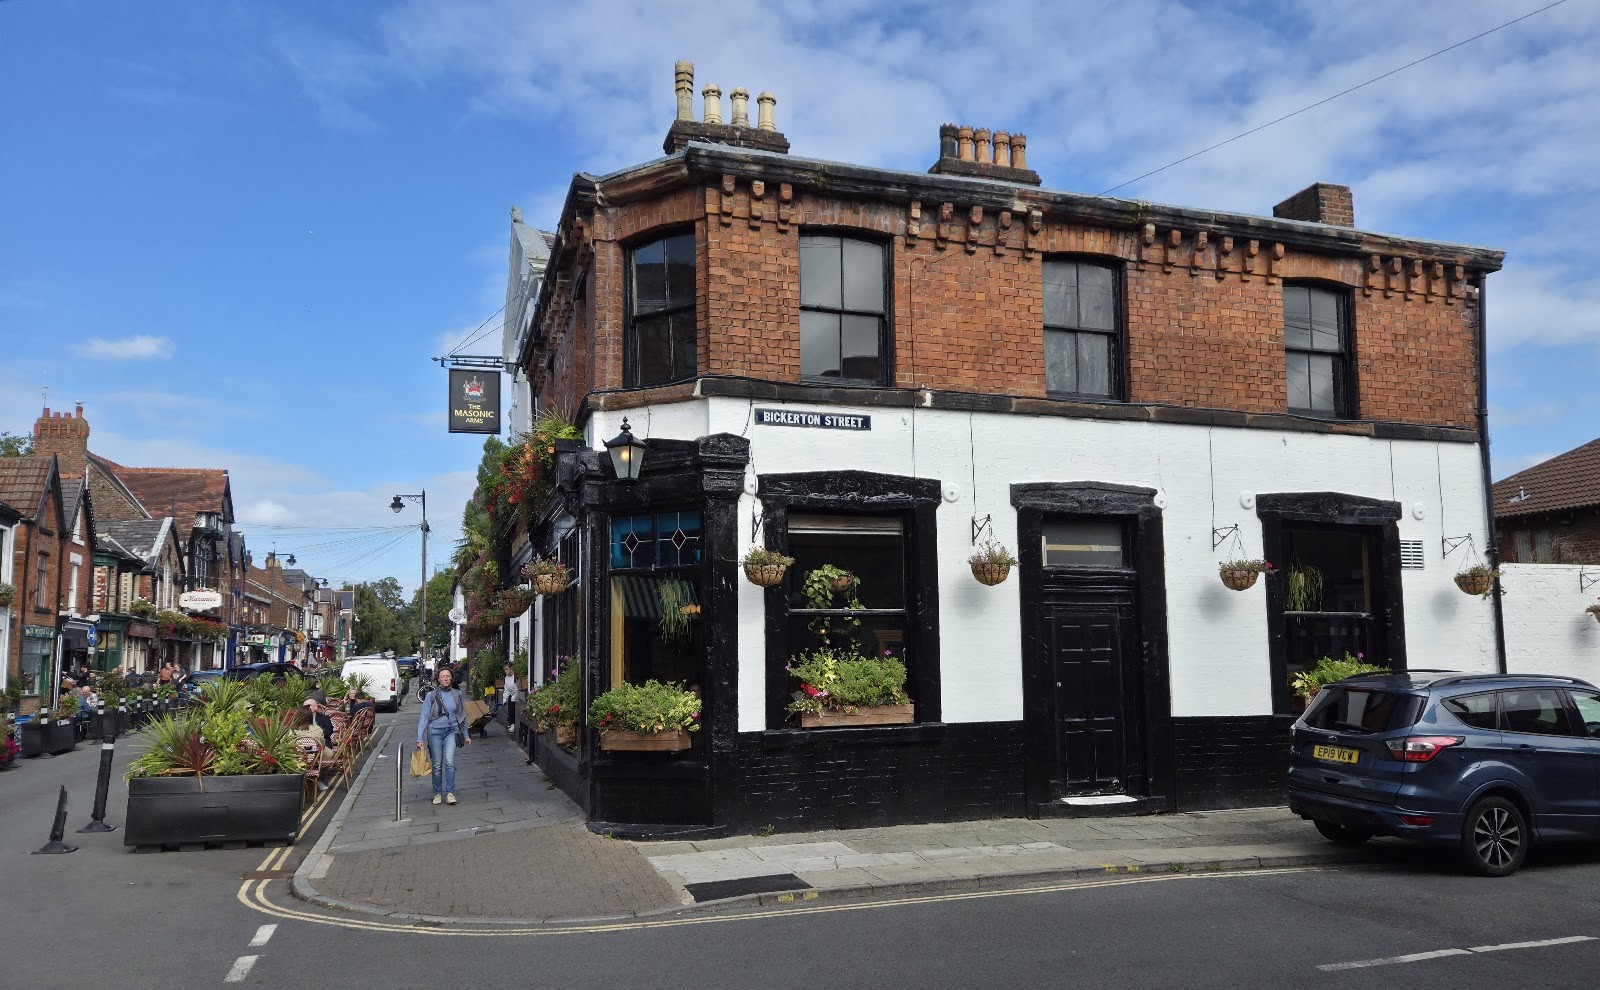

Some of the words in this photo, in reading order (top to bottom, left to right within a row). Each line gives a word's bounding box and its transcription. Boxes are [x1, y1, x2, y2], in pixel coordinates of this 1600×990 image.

[454, 409, 494, 418] MASONIC
[763, 410, 820, 425] BICKERTON
[1317, 747, 1336, 759] EP19
[1337, 749, 1354, 761] VCW
